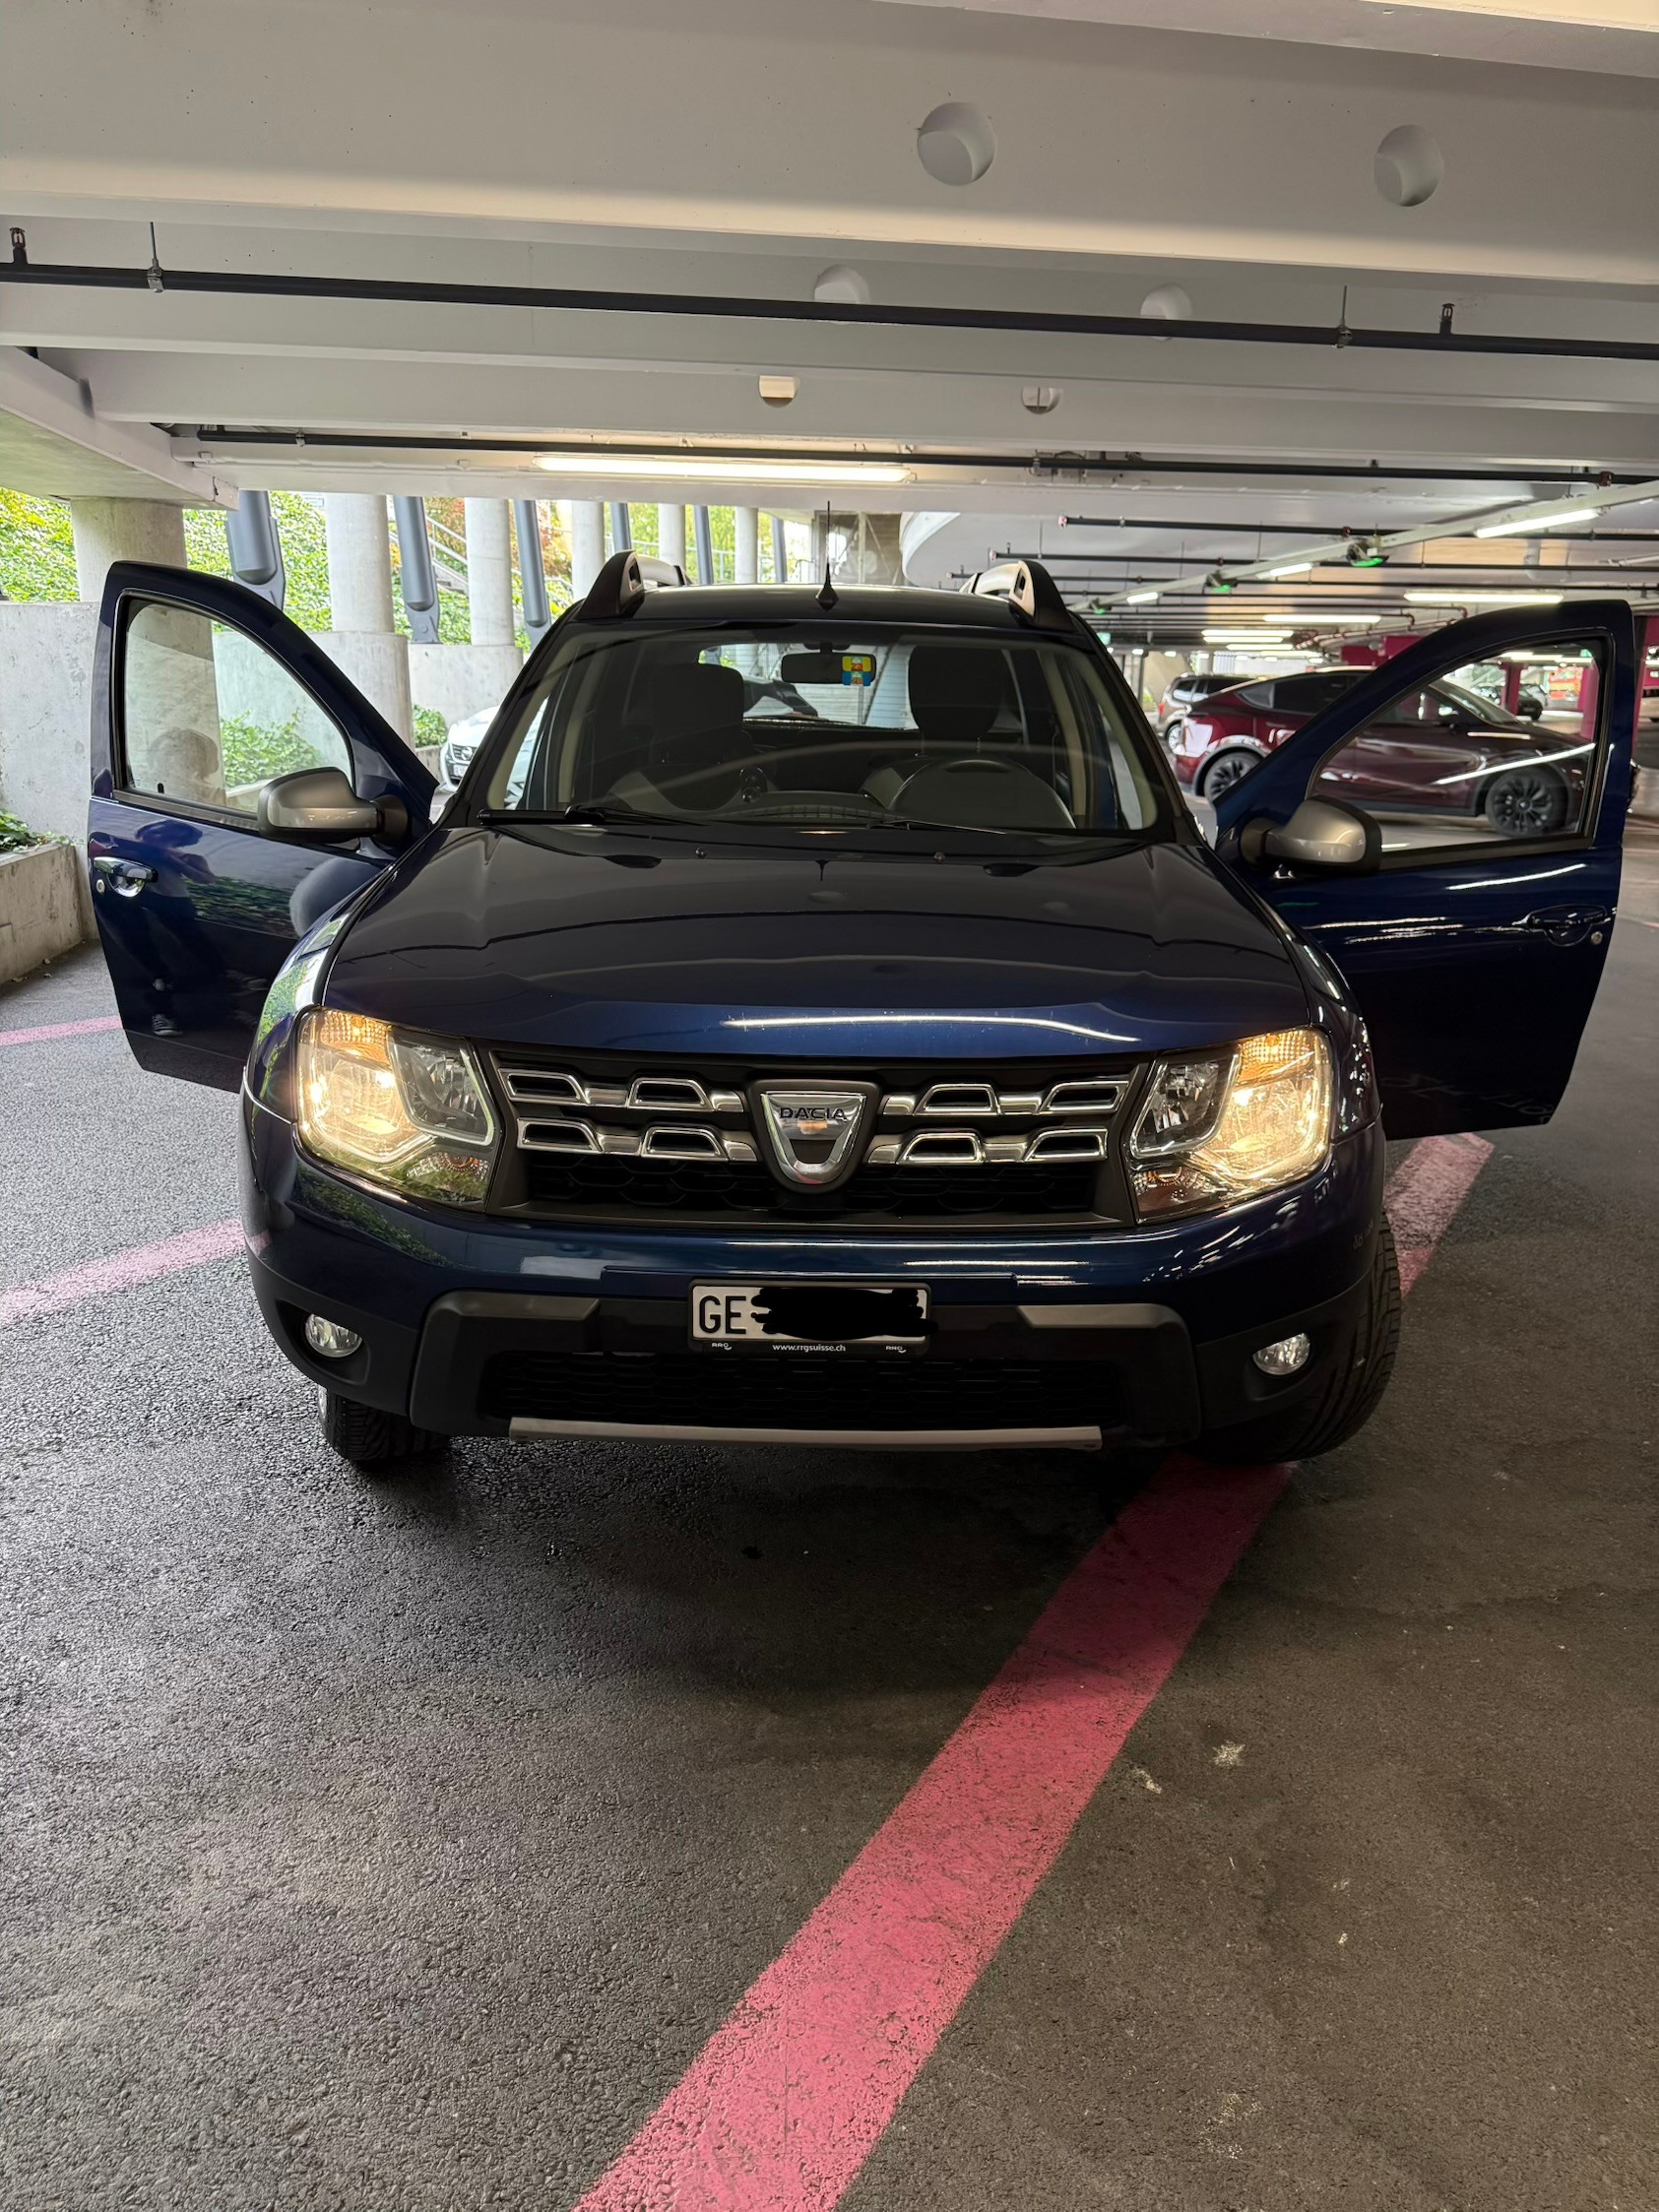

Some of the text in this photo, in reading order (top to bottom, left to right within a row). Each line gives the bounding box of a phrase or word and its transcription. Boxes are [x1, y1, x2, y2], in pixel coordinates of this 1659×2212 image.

[780, 1107, 847, 1121] DACIA
[699, 1296, 746, 1334] GE
[772, 1344, 846, 1353] www.rrgsuisse.ch
